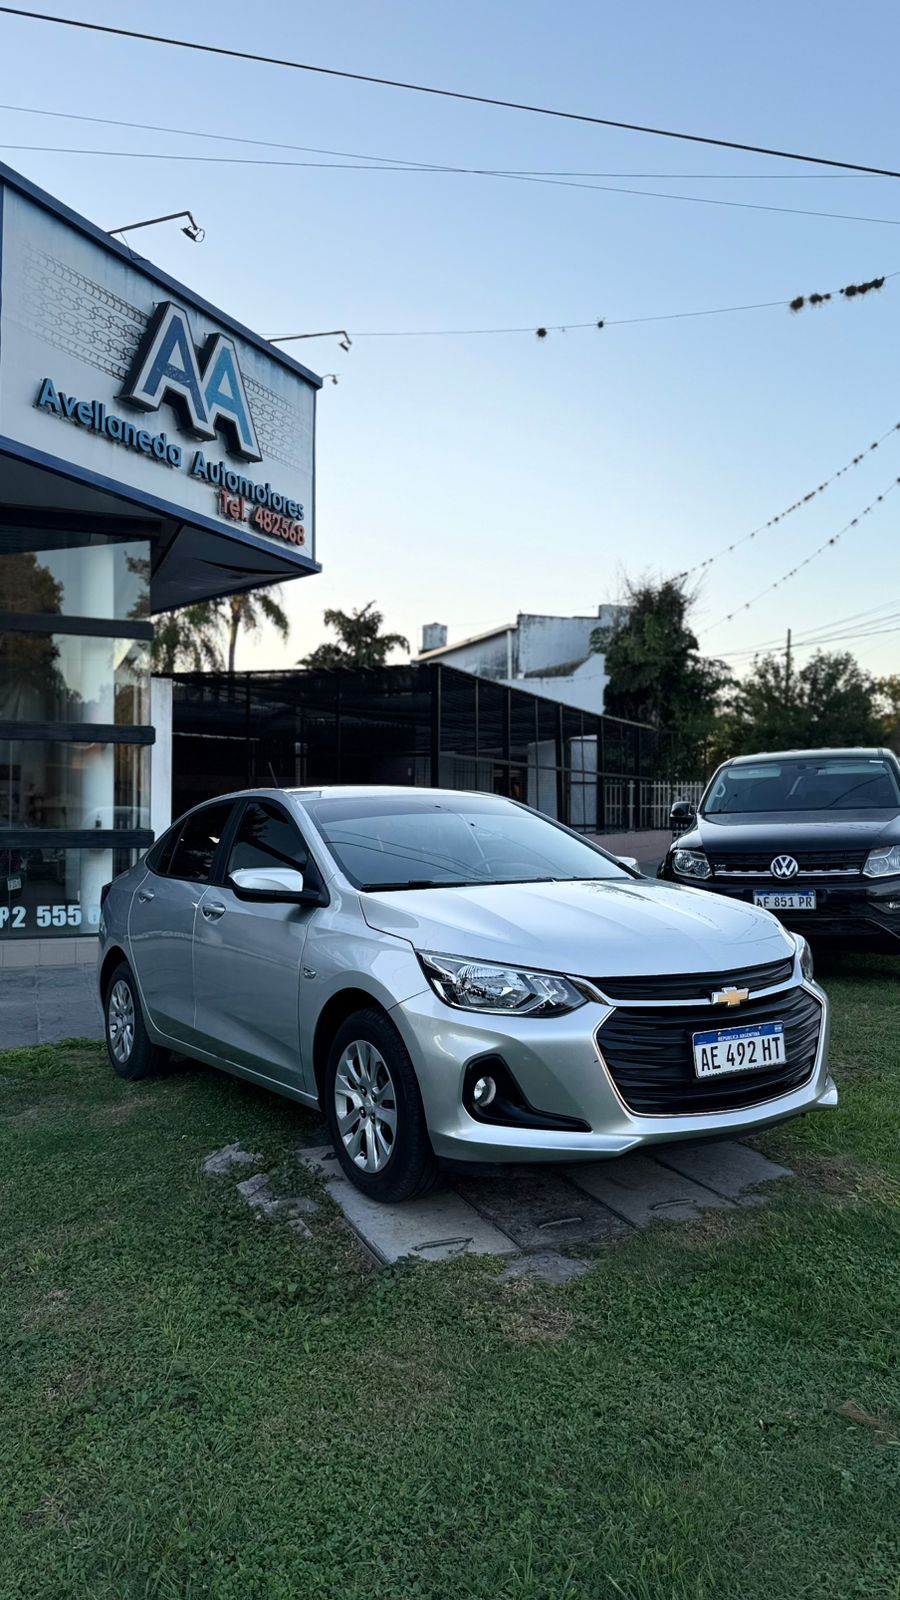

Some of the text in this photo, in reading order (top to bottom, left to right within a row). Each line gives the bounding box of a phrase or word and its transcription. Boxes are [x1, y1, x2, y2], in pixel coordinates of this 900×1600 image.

[37, 377, 304, 521] Avellaneda Automotores
[253, 505, 305, 546] 482568
[36, 905, 81, 927] 555
[756, 896, 812, 908] AF 851 PR
[701, 1036, 780, 1071] AE 492 HT
